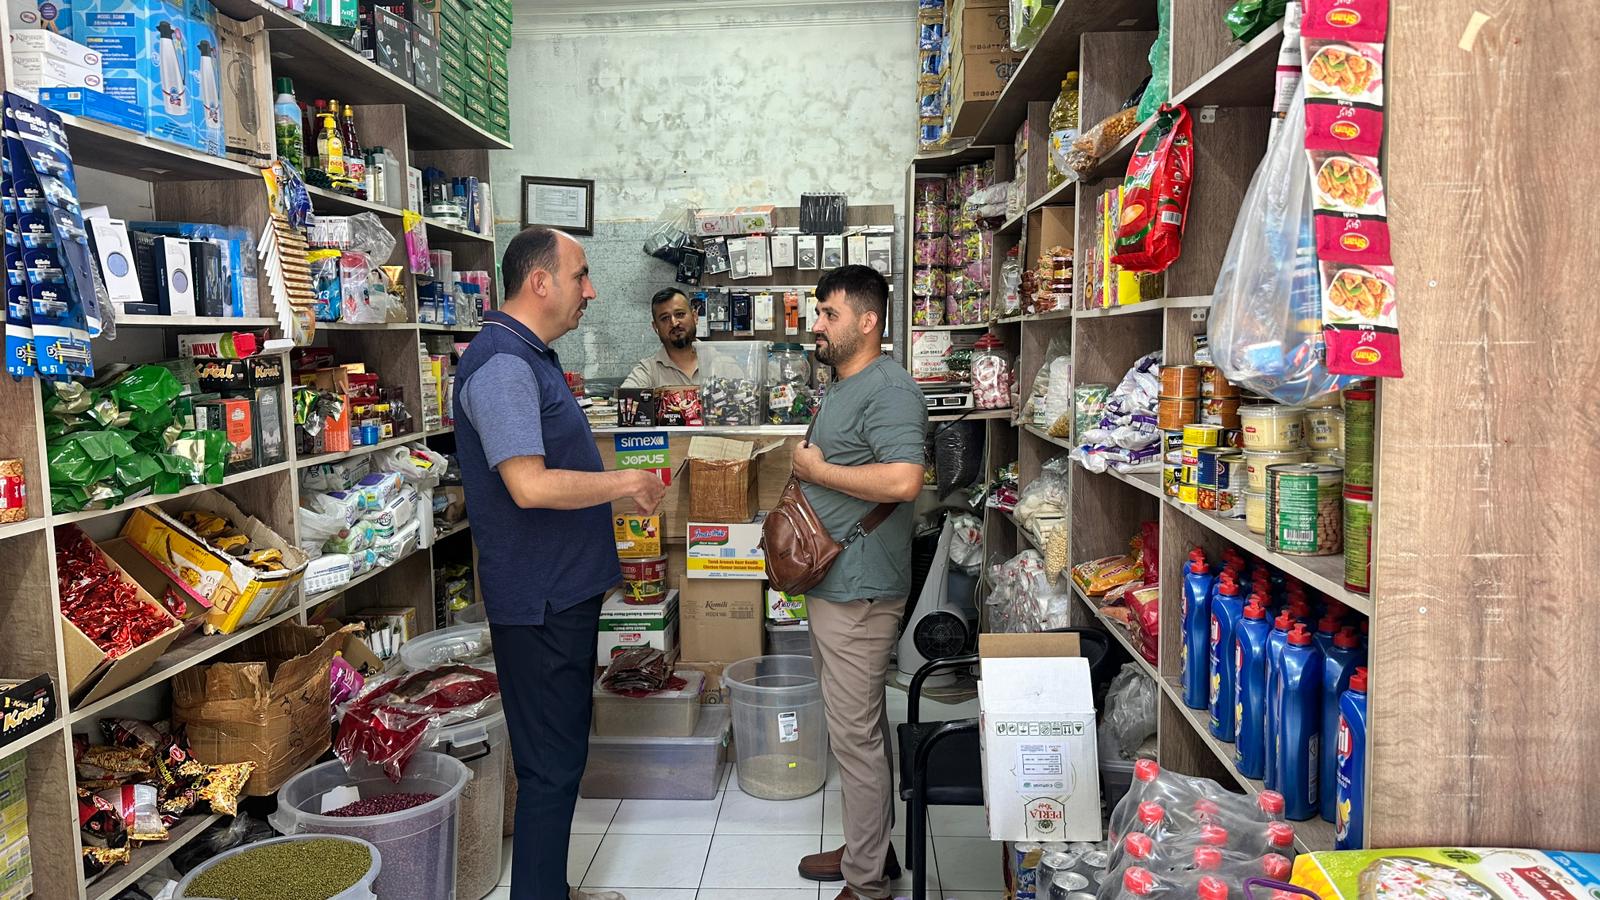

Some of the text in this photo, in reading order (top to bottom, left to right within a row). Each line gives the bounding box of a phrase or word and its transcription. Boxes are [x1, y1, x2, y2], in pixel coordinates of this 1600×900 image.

[1331, 13, 1357, 25] Shan
[15, 110, 47, 128] Gillette
[1335, 126, 1356, 137] Shan
[1344, 236, 1369, 249] Shan
[1354, 351, 1378, 363] Shan
[621, 436, 657, 447] simex
[622, 454, 665, 465] JOPUS
[1029, 809, 1062, 820] PERLA
